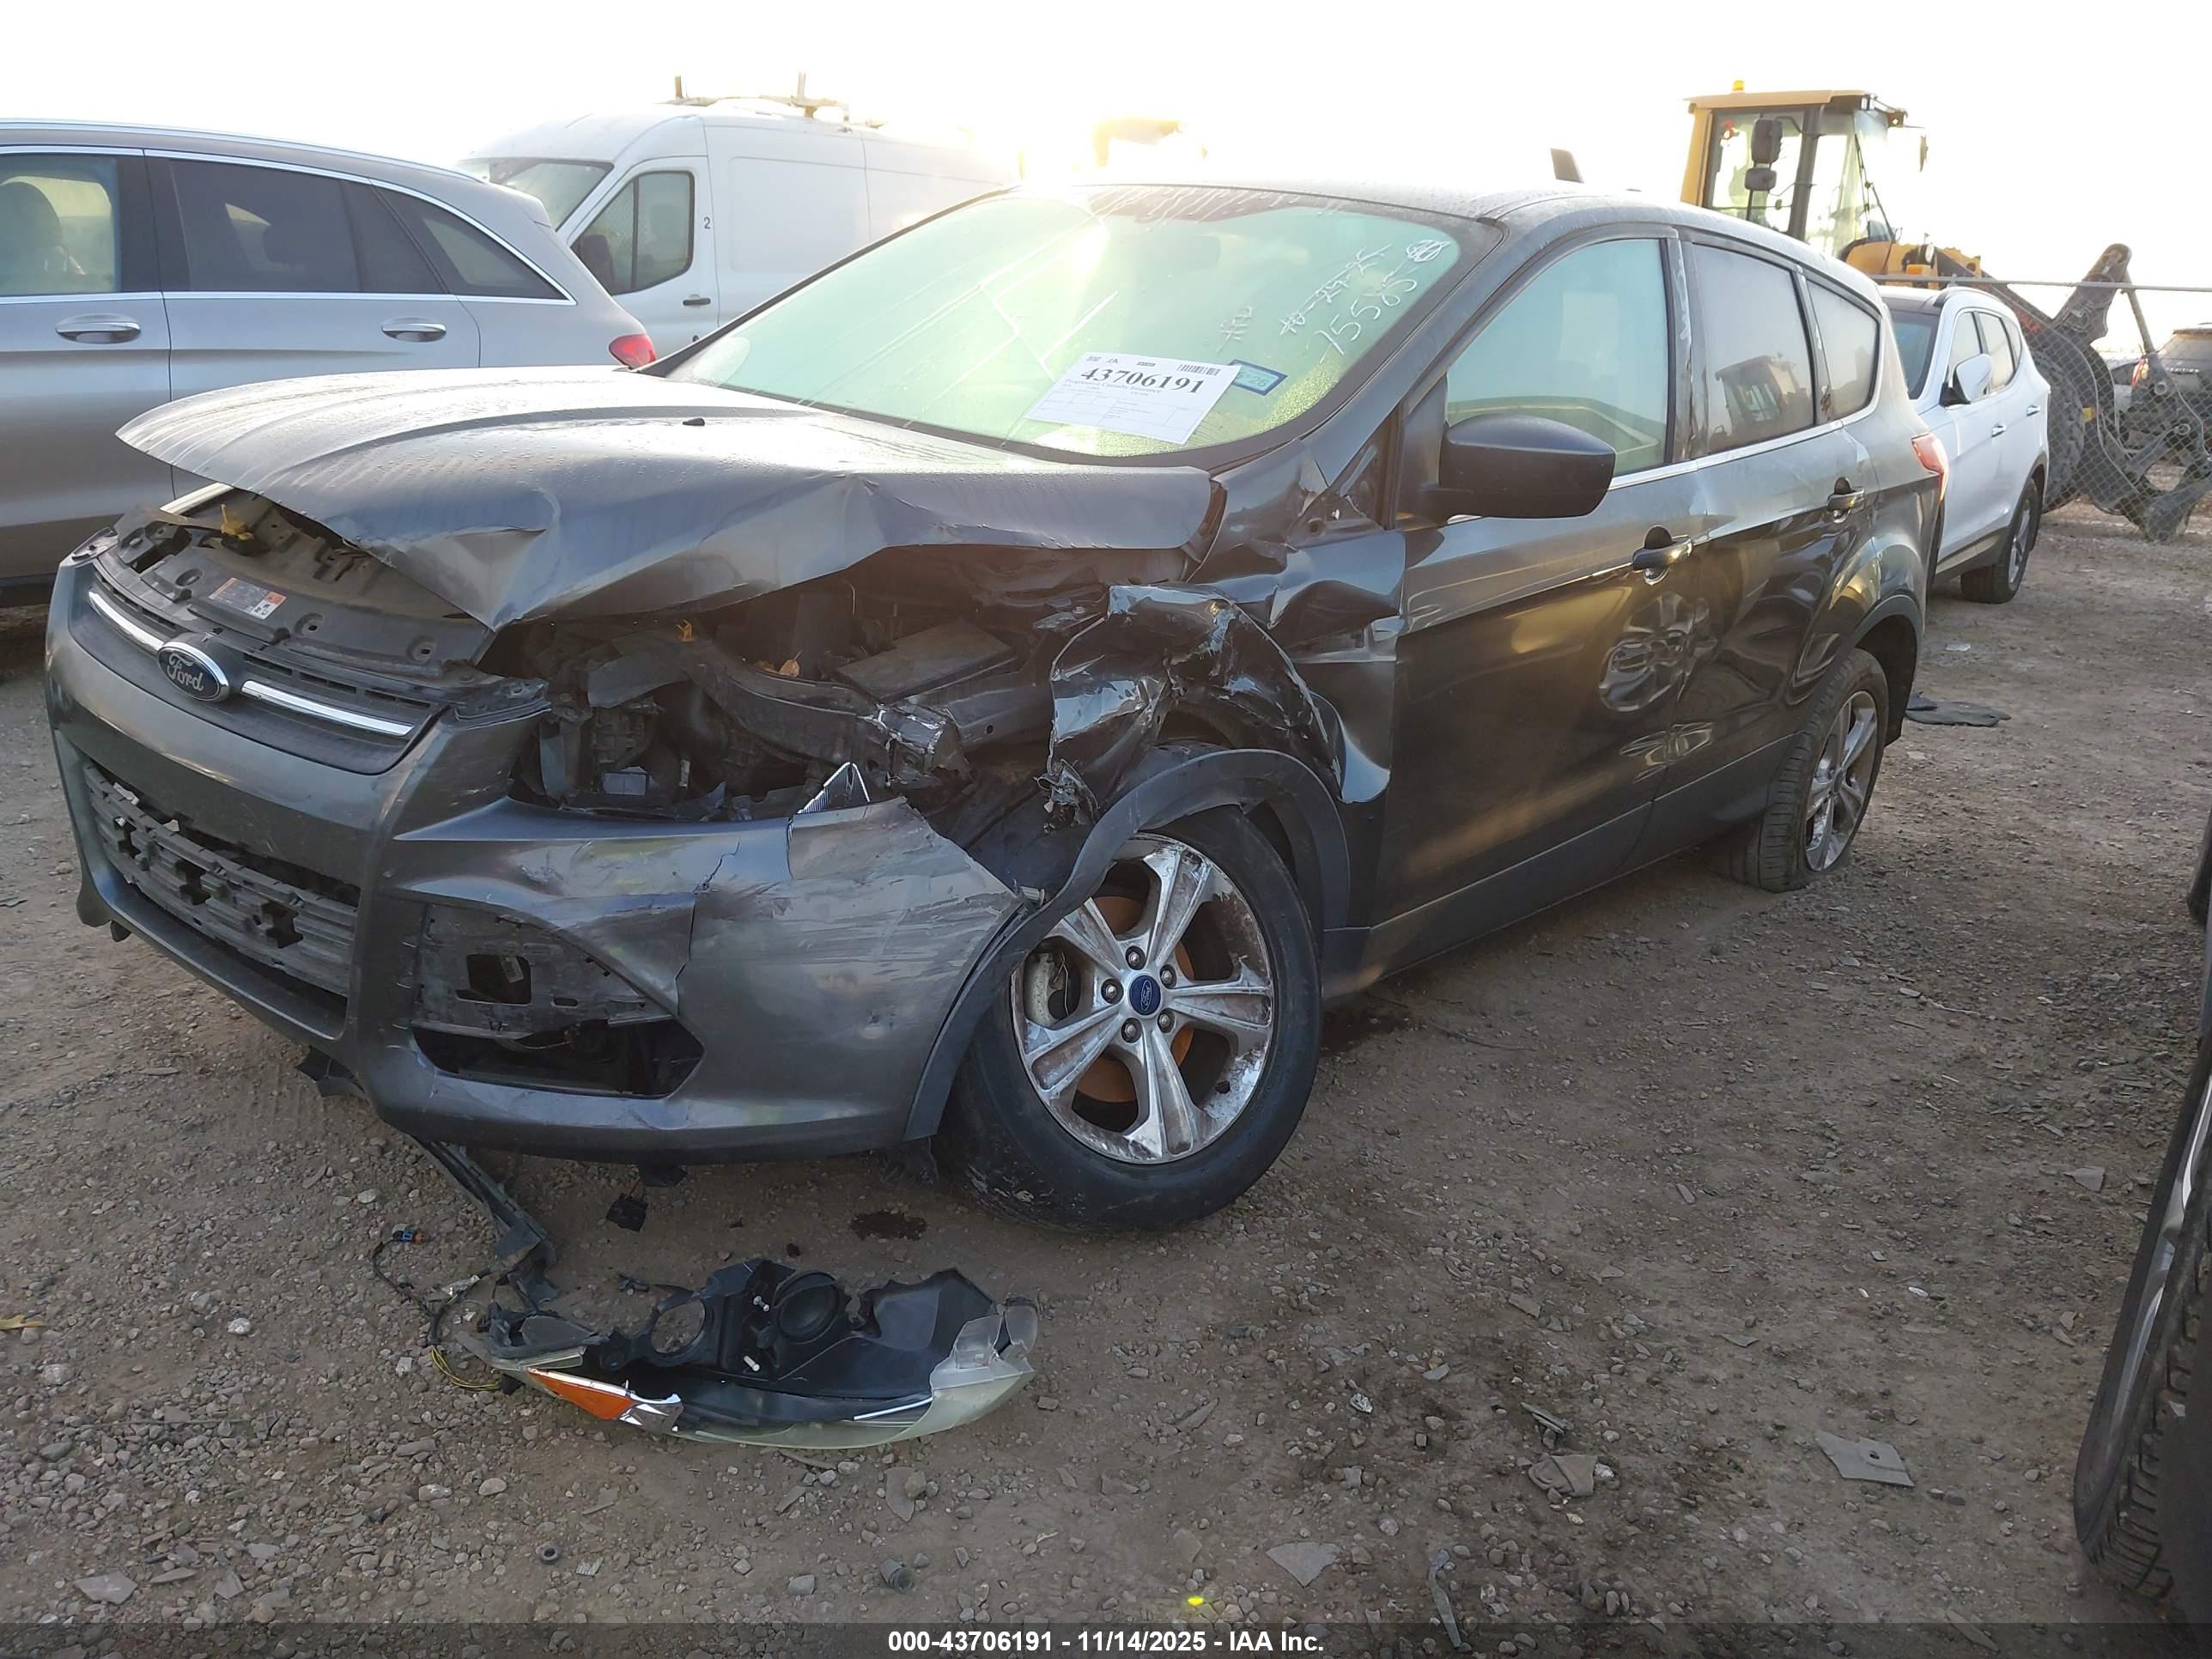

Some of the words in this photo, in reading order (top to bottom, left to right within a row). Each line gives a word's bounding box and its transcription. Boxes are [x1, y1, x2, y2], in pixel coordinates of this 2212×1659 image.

[703, 216, 711, 230] 2
[1081, 367, 1204, 394] 43706191
[167, 653, 204, 692] Ford
